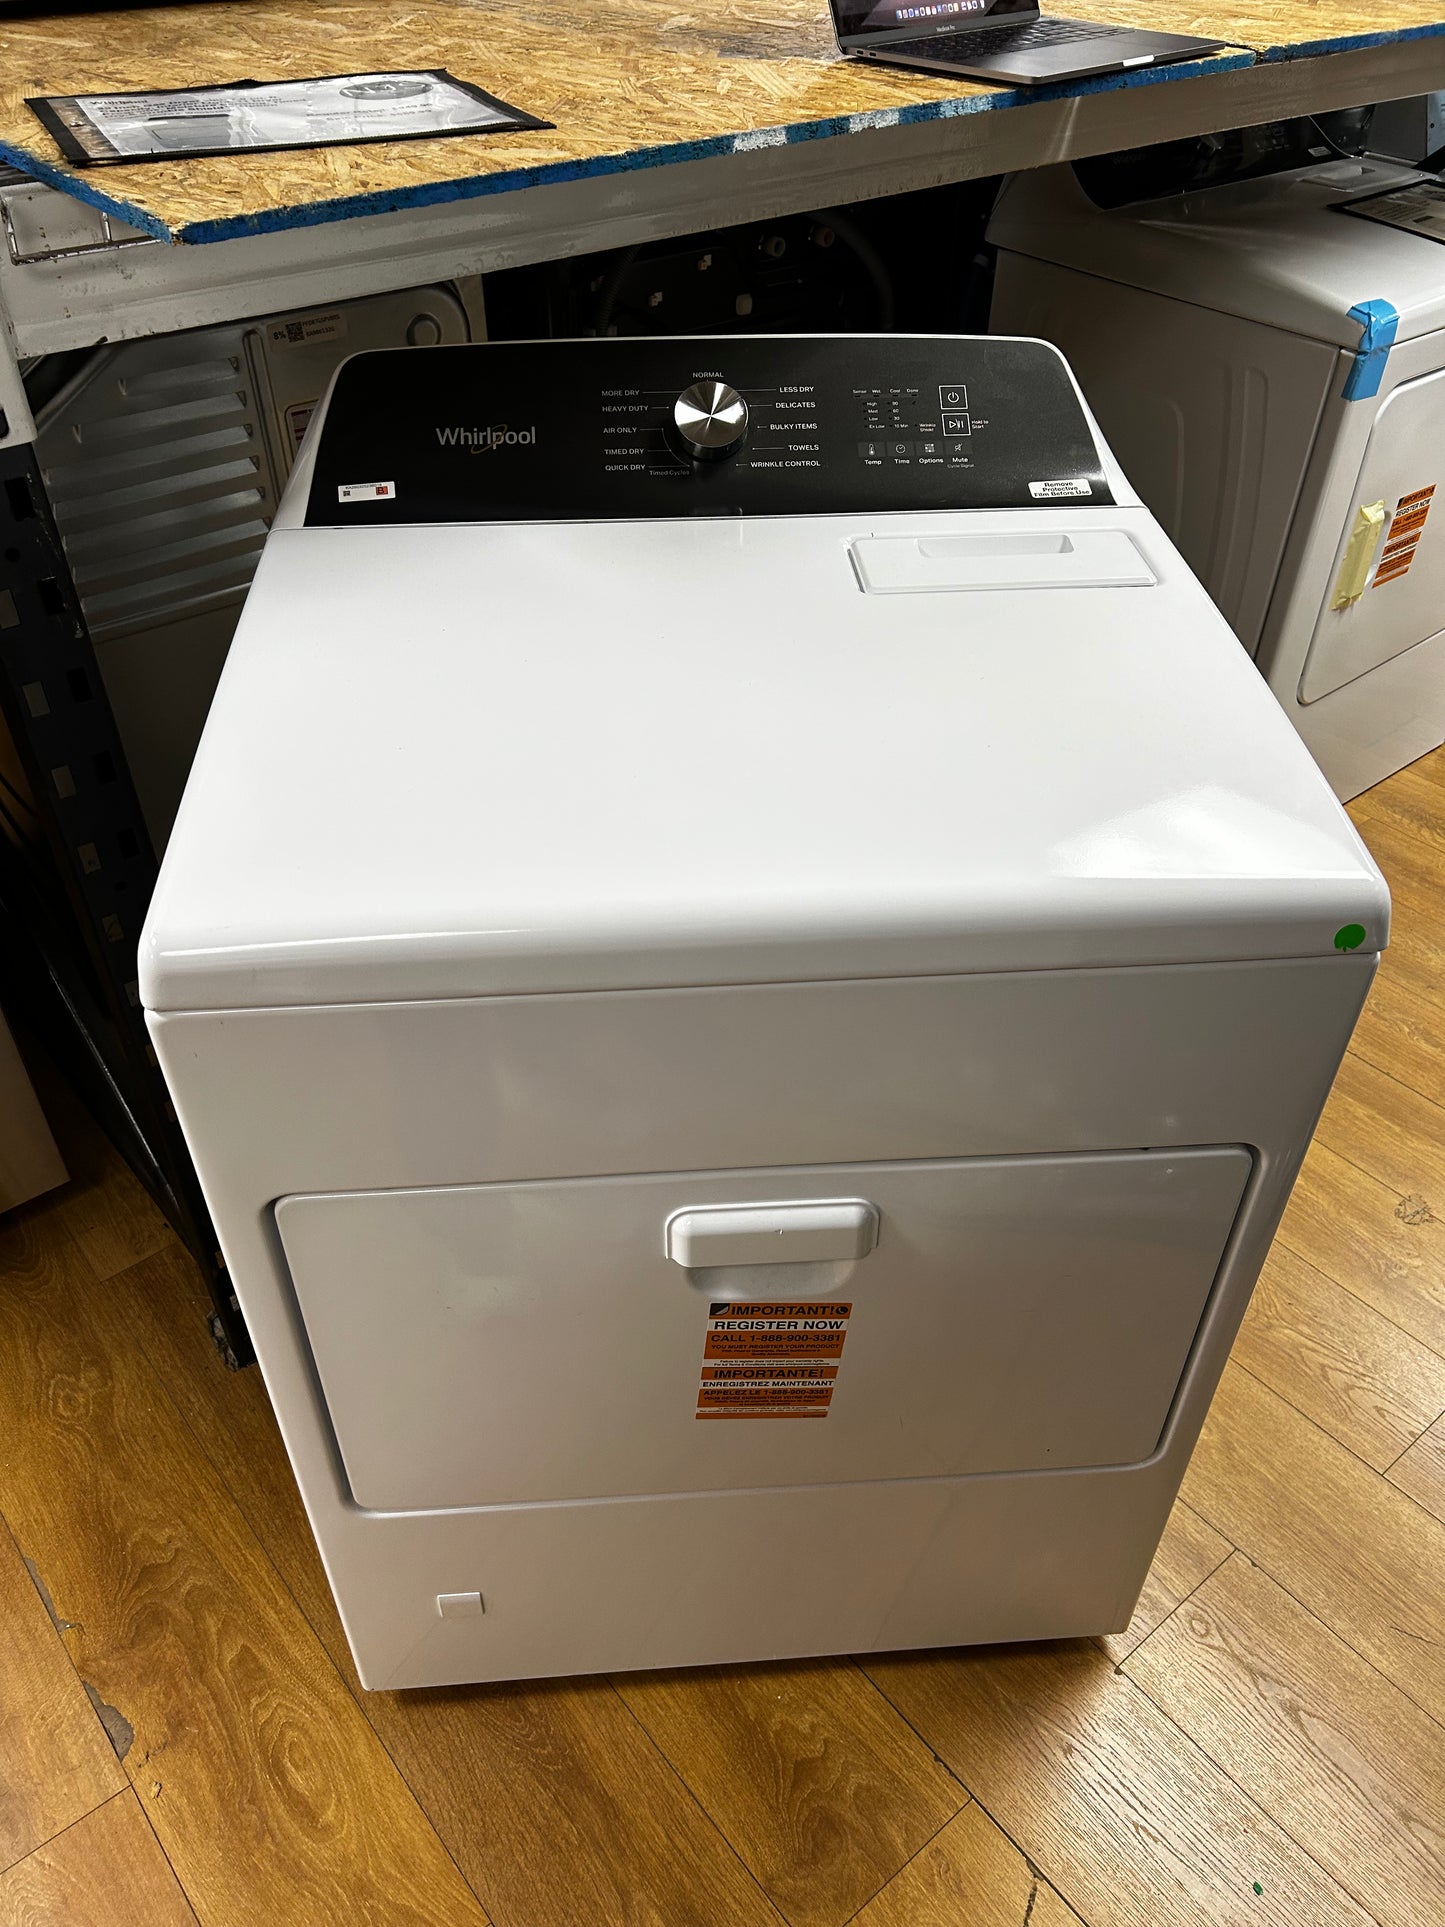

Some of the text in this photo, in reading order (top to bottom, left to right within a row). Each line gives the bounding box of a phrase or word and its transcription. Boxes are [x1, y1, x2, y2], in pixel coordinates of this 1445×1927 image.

[273, 331, 287, 341] 8%
[436, 427, 536, 449] Whirlpool
[731, 1306, 834, 1315] IMPORTANT!
[714, 1321, 844, 1330] REGISTER NOW
[750, 1334, 841, 1342] 1-888-900-3381
[714, 1369, 824, 1378] IMPORTANTE!
